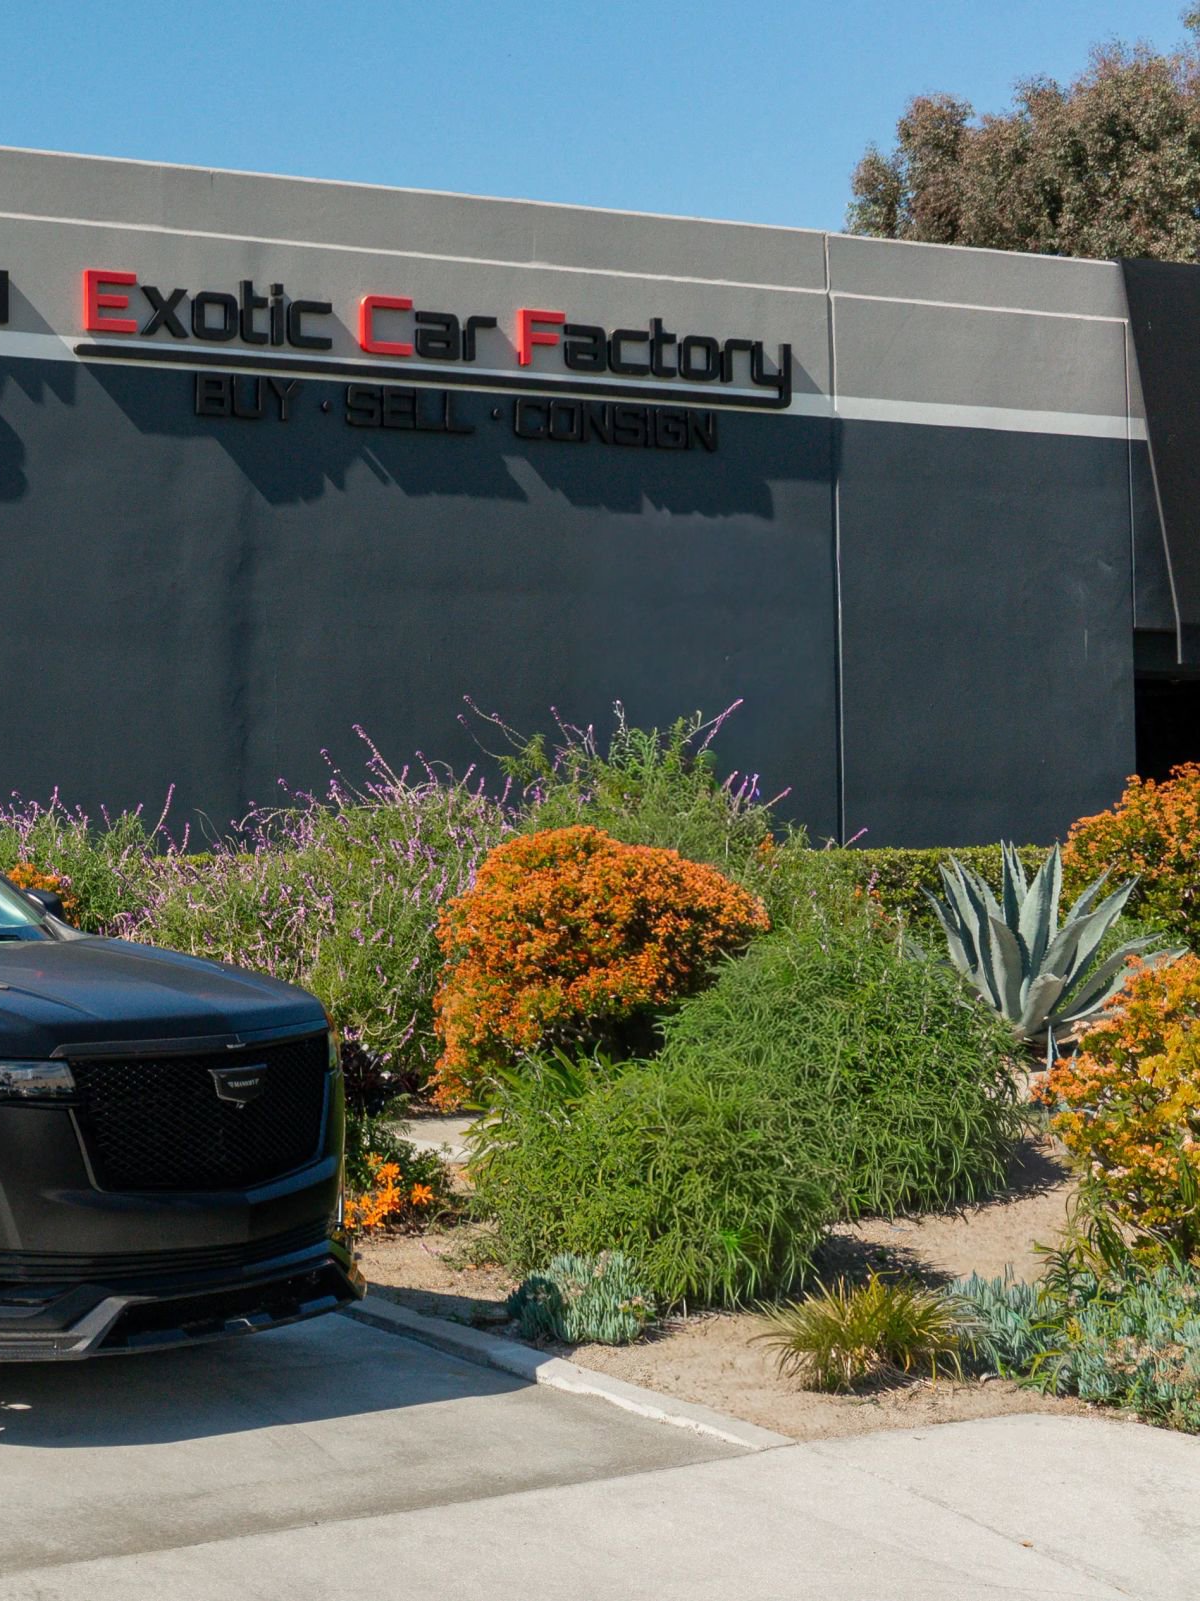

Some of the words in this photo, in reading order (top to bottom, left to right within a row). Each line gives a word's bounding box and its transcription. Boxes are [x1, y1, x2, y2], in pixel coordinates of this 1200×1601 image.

[82, 269, 333, 351] Exotic
[359, 295, 497, 361] Car
[517, 308, 792, 409] Factory
[194, 372, 297, 421] BUY
[345, 384, 475, 434] SELL
[514, 398, 718, 452] CONSIGN
